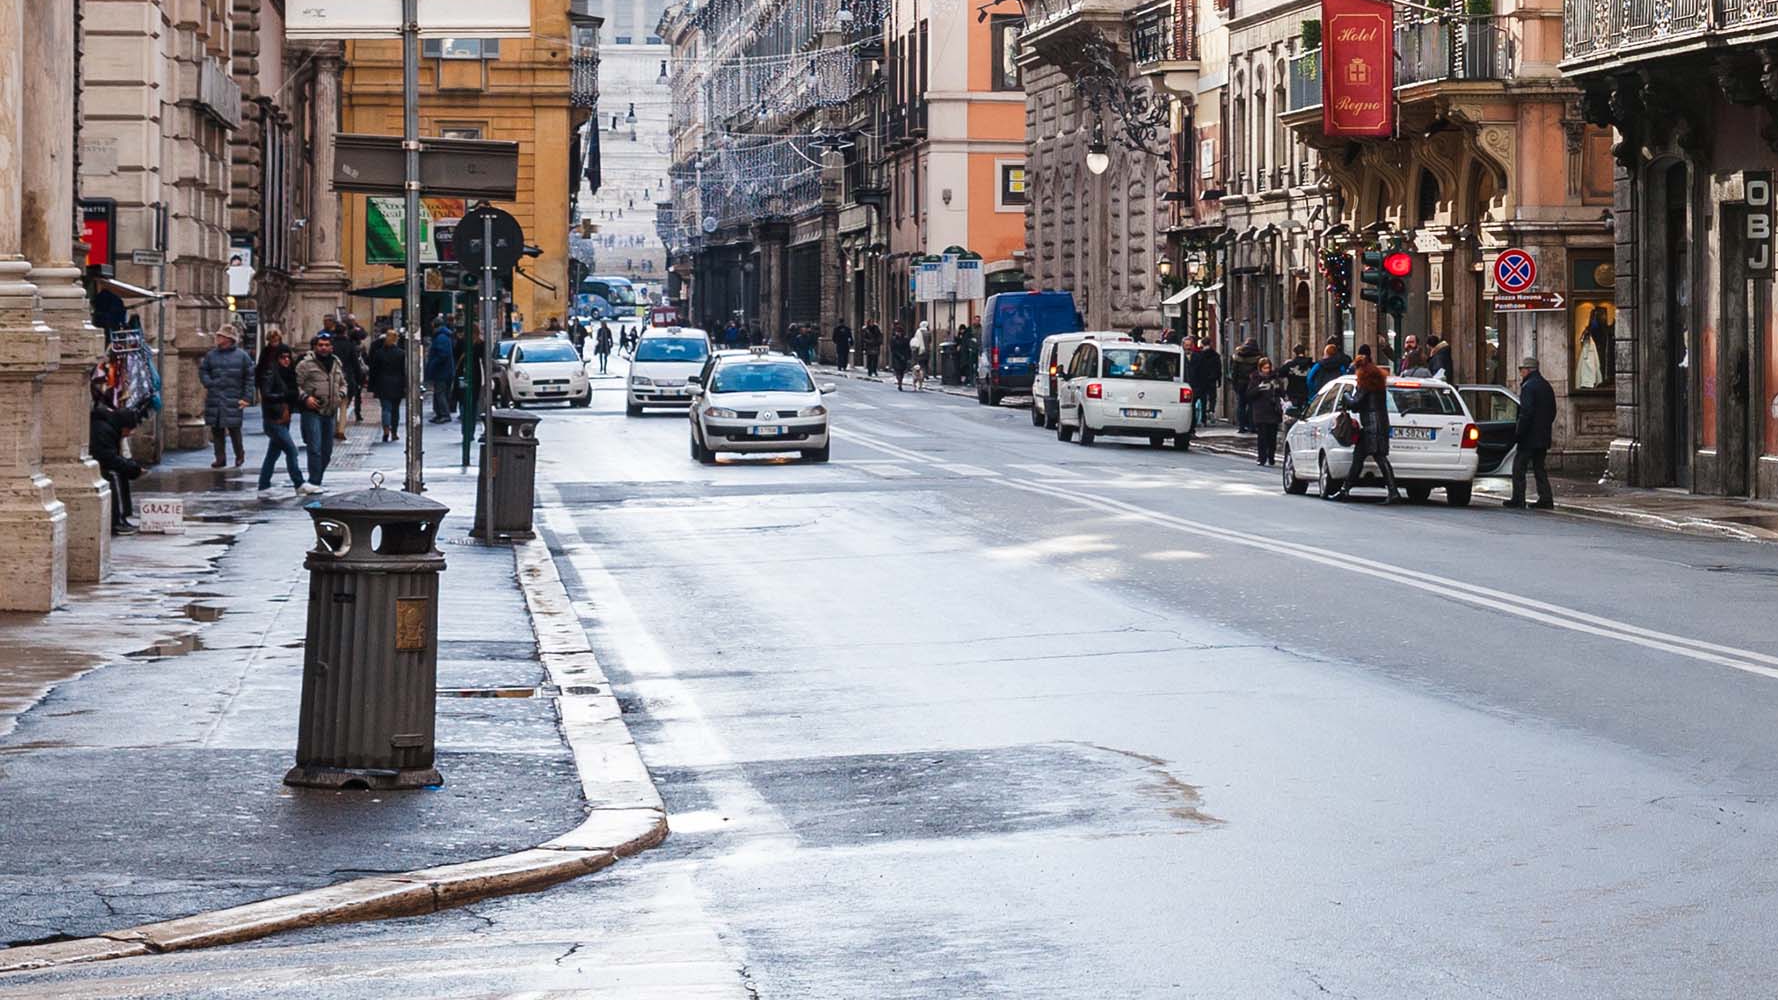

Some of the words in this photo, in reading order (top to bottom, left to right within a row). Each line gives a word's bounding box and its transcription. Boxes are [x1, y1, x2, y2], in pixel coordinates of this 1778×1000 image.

[1337, 27, 1377, 41] Hotel
[1335, 96, 1380, 116] Regno
[1746, 180, 1770, 270] OBJ
[142, 504, 182, 514] GRAZIE
